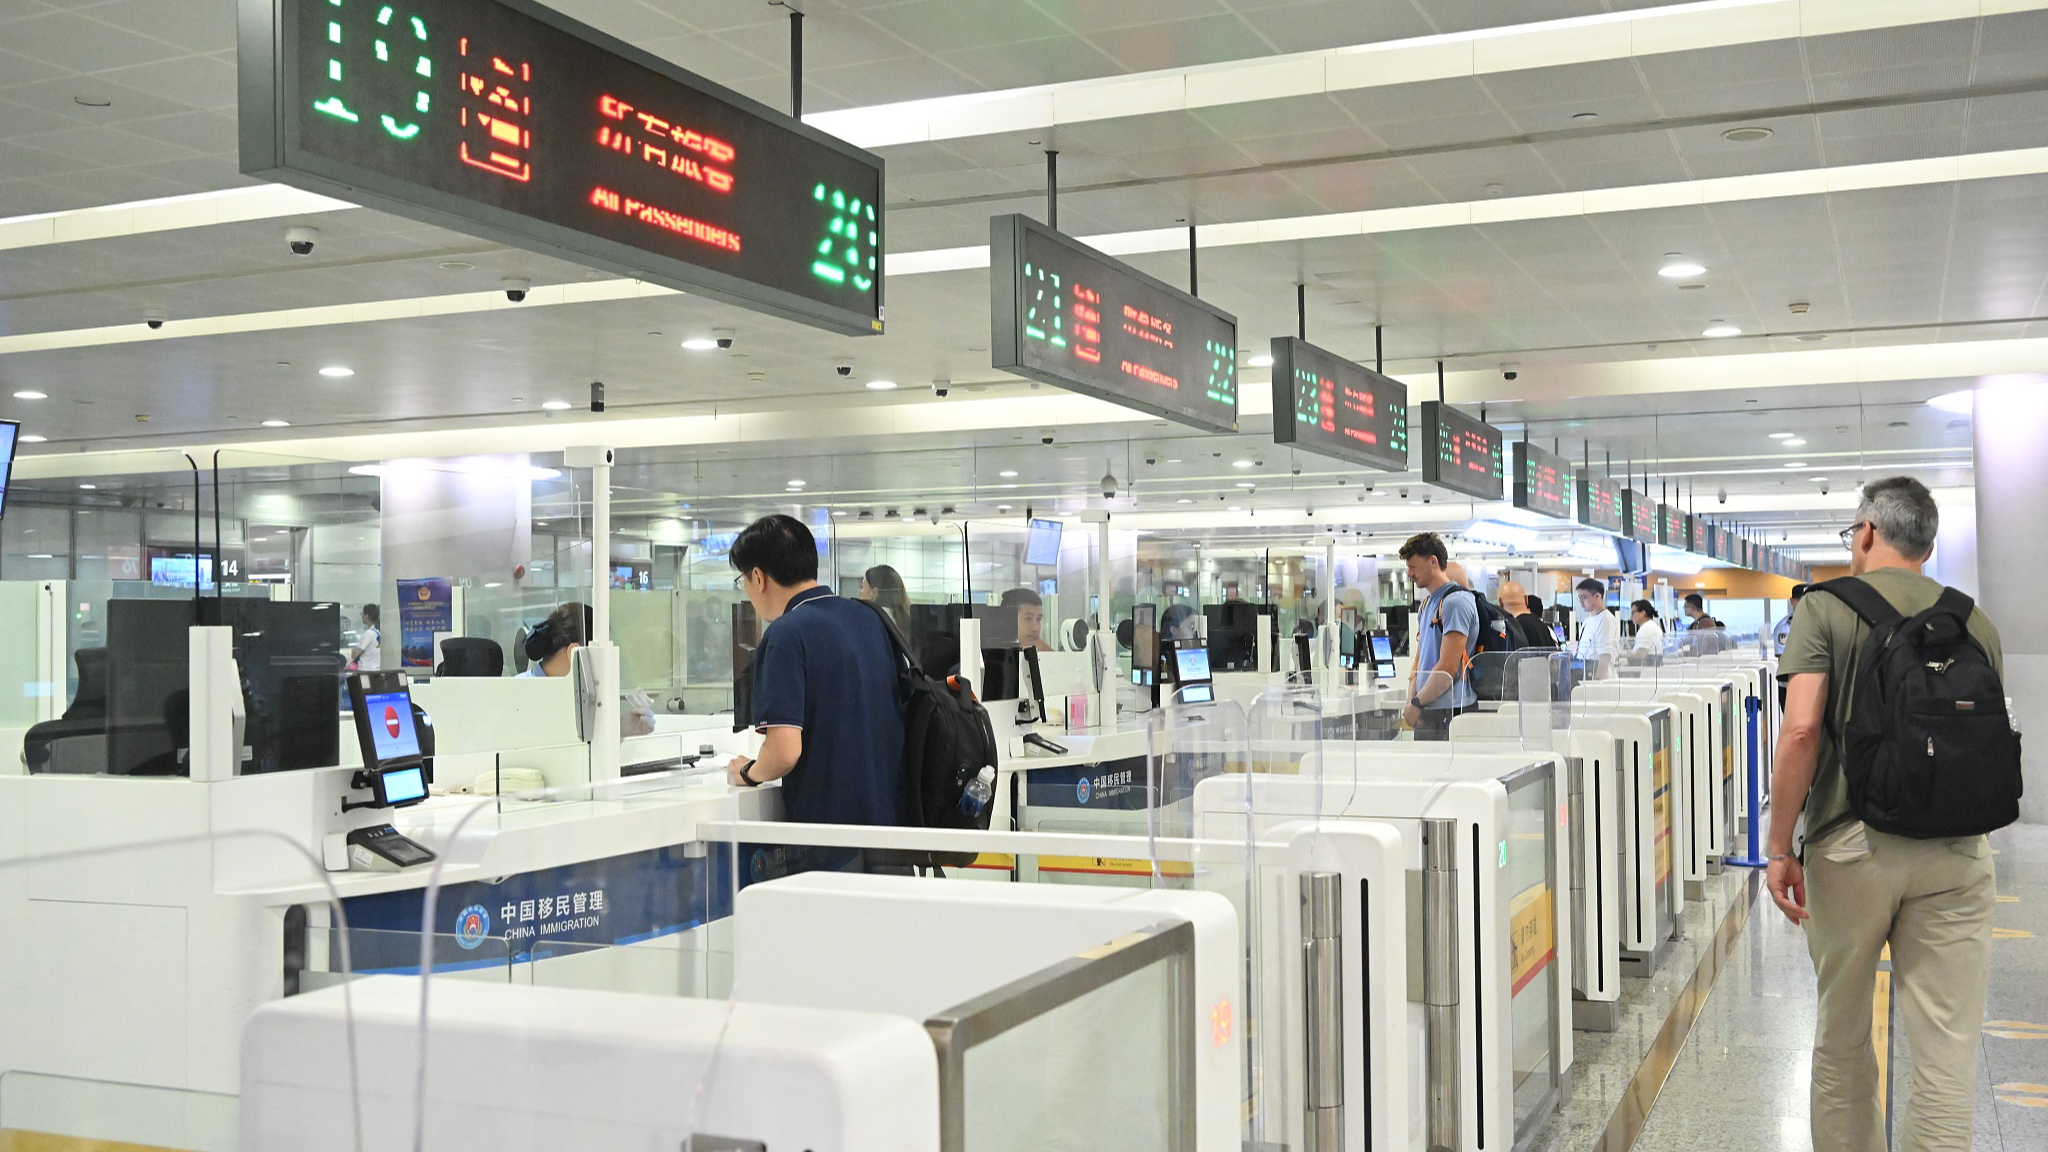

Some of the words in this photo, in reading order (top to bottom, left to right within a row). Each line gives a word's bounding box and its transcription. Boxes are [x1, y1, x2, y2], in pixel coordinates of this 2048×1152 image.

[221, 560, 239, 577] 14
[638, 571, 649, 585] 16
[1093, 770, 1132, 790] 中国移民管理
[1095, 790, 1108, 800] CHINA
[1498, 840, 1507, 869] 20
[500, 890, 604, 925] 中国移民管理
[504, 926, 536, 941] CHINA
[540, 915, 600, 935] IMMIGRATION
[1209, 998, 1231, 1049] 19
